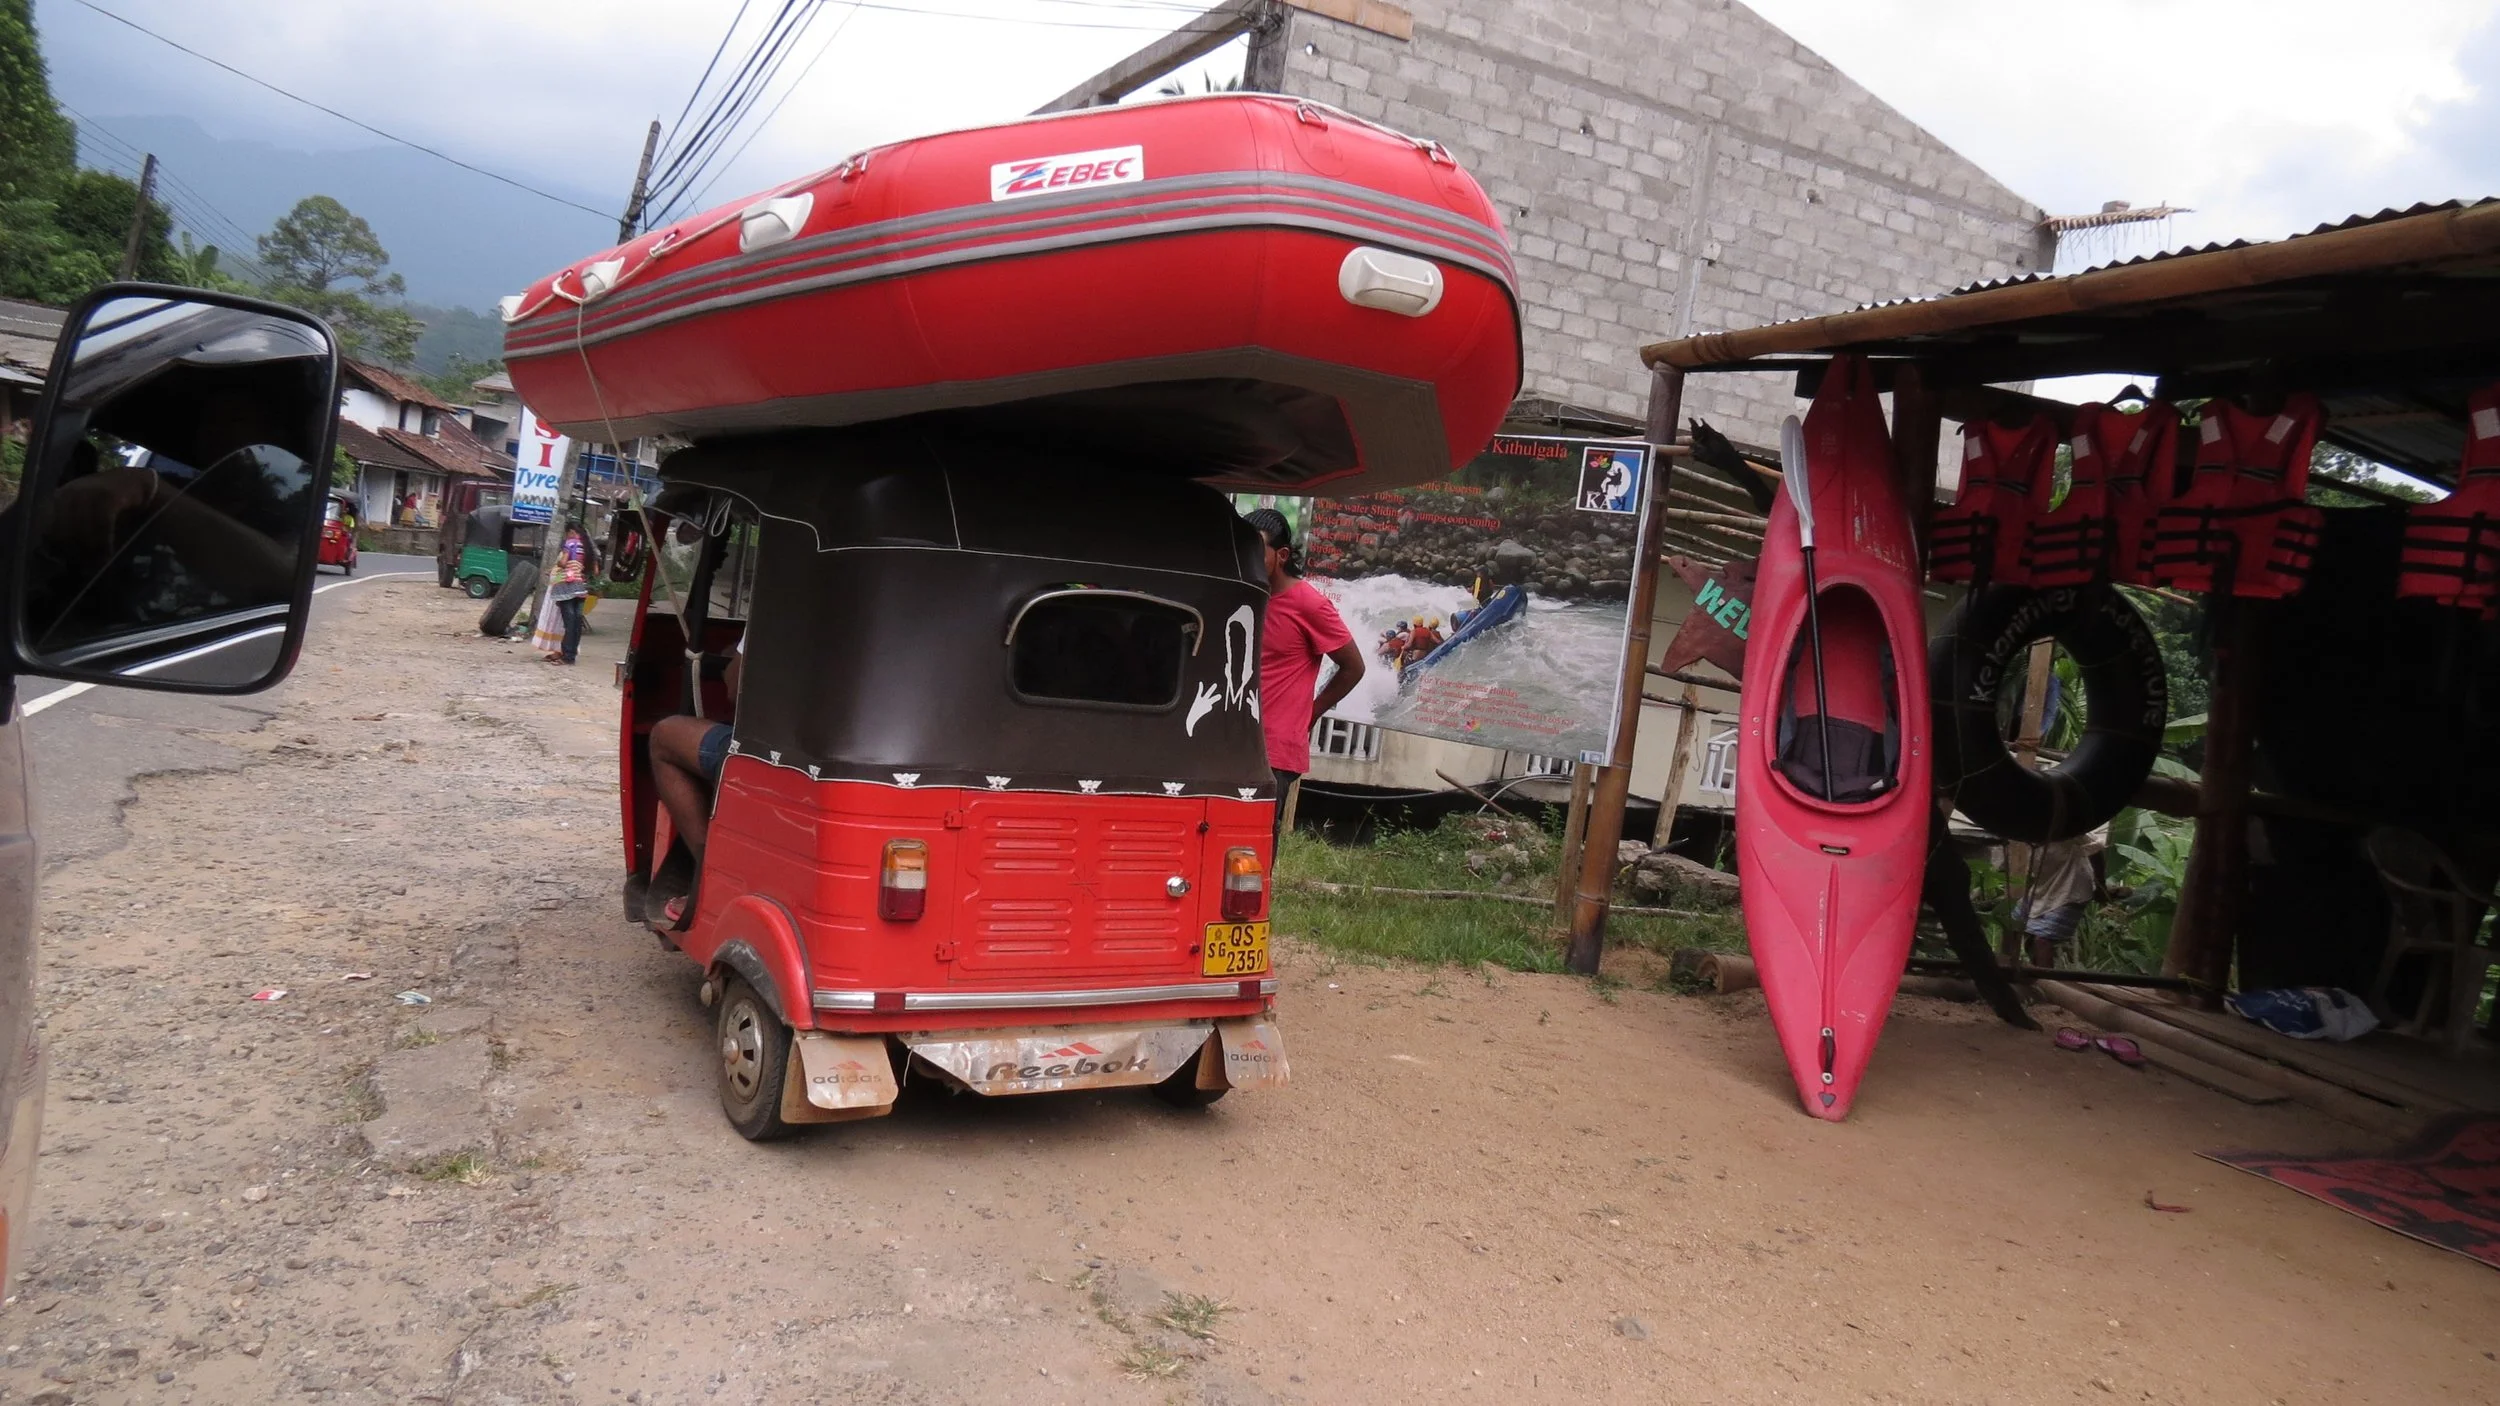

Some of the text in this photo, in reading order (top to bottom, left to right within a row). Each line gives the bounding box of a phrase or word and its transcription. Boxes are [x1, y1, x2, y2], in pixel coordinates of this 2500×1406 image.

[1003, 157, 1136, 194] ZEBEC
[1492, 440, 1568, 460] Kithulgala
[1226, 949, 1264, 973] 2359
[812, 1073, 882, 1085] adidas
[985, 1055, 1150, 1081] Reebok
